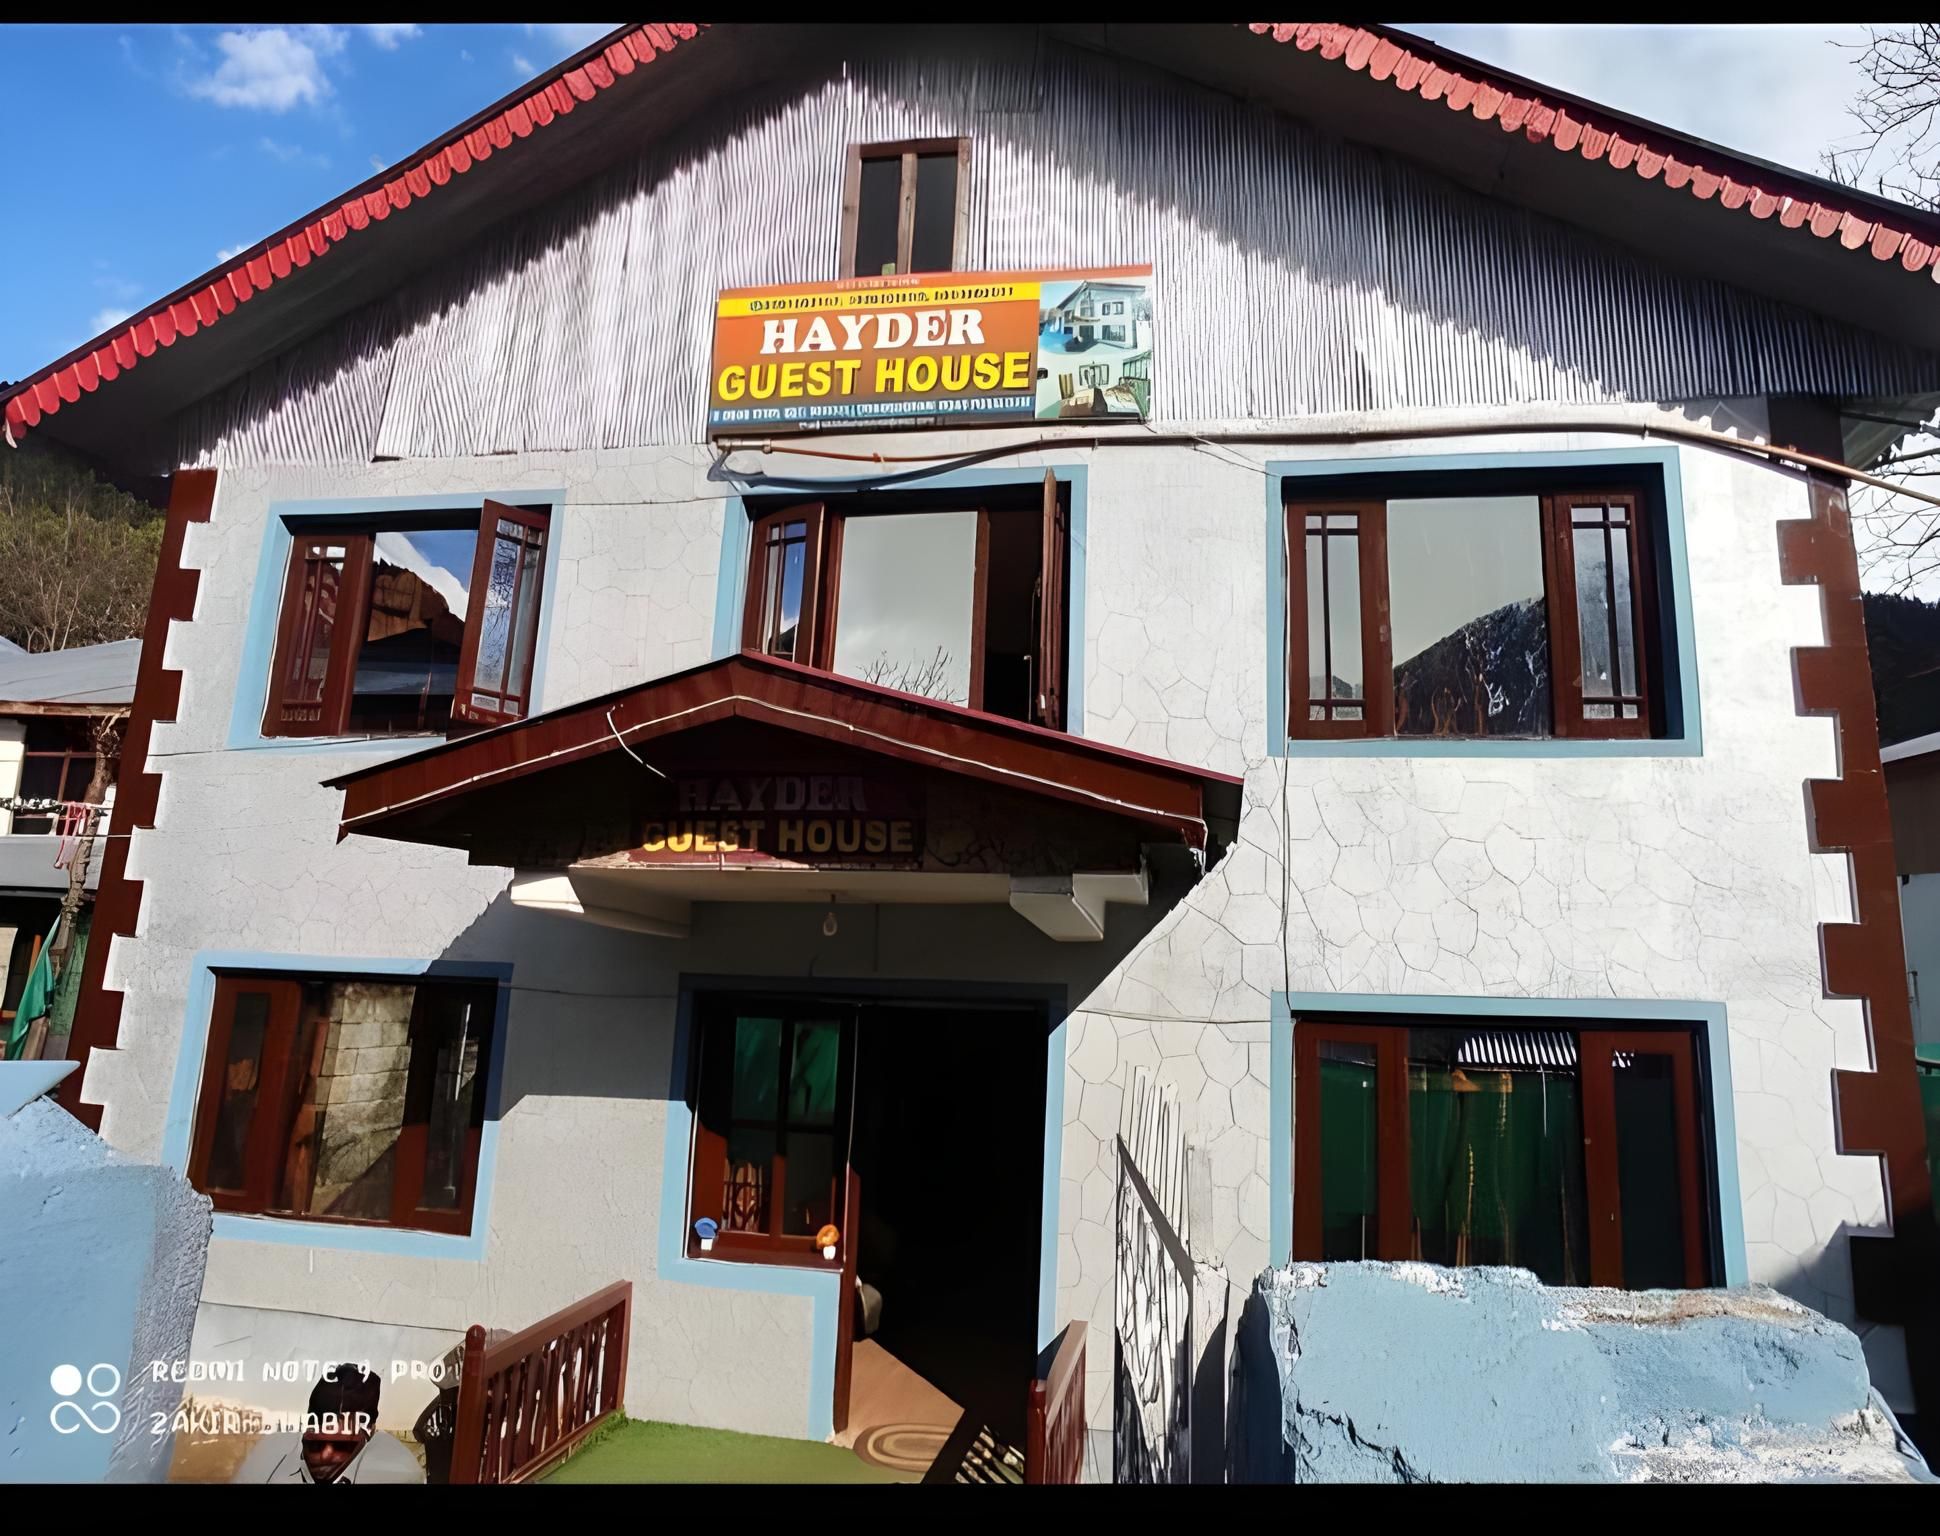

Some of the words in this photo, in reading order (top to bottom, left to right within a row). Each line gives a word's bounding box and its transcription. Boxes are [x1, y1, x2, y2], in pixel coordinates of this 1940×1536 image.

[759, 308, 986, 355] HAYDER
[718, 358, 863, 401] GUEST
[875, 351, 1033, 394] HOUSE
[678, 776, 868, 812] HAYDER
[642, 819, 765, 853] GUEST
[778, 819, 914, 853] HOUSE
